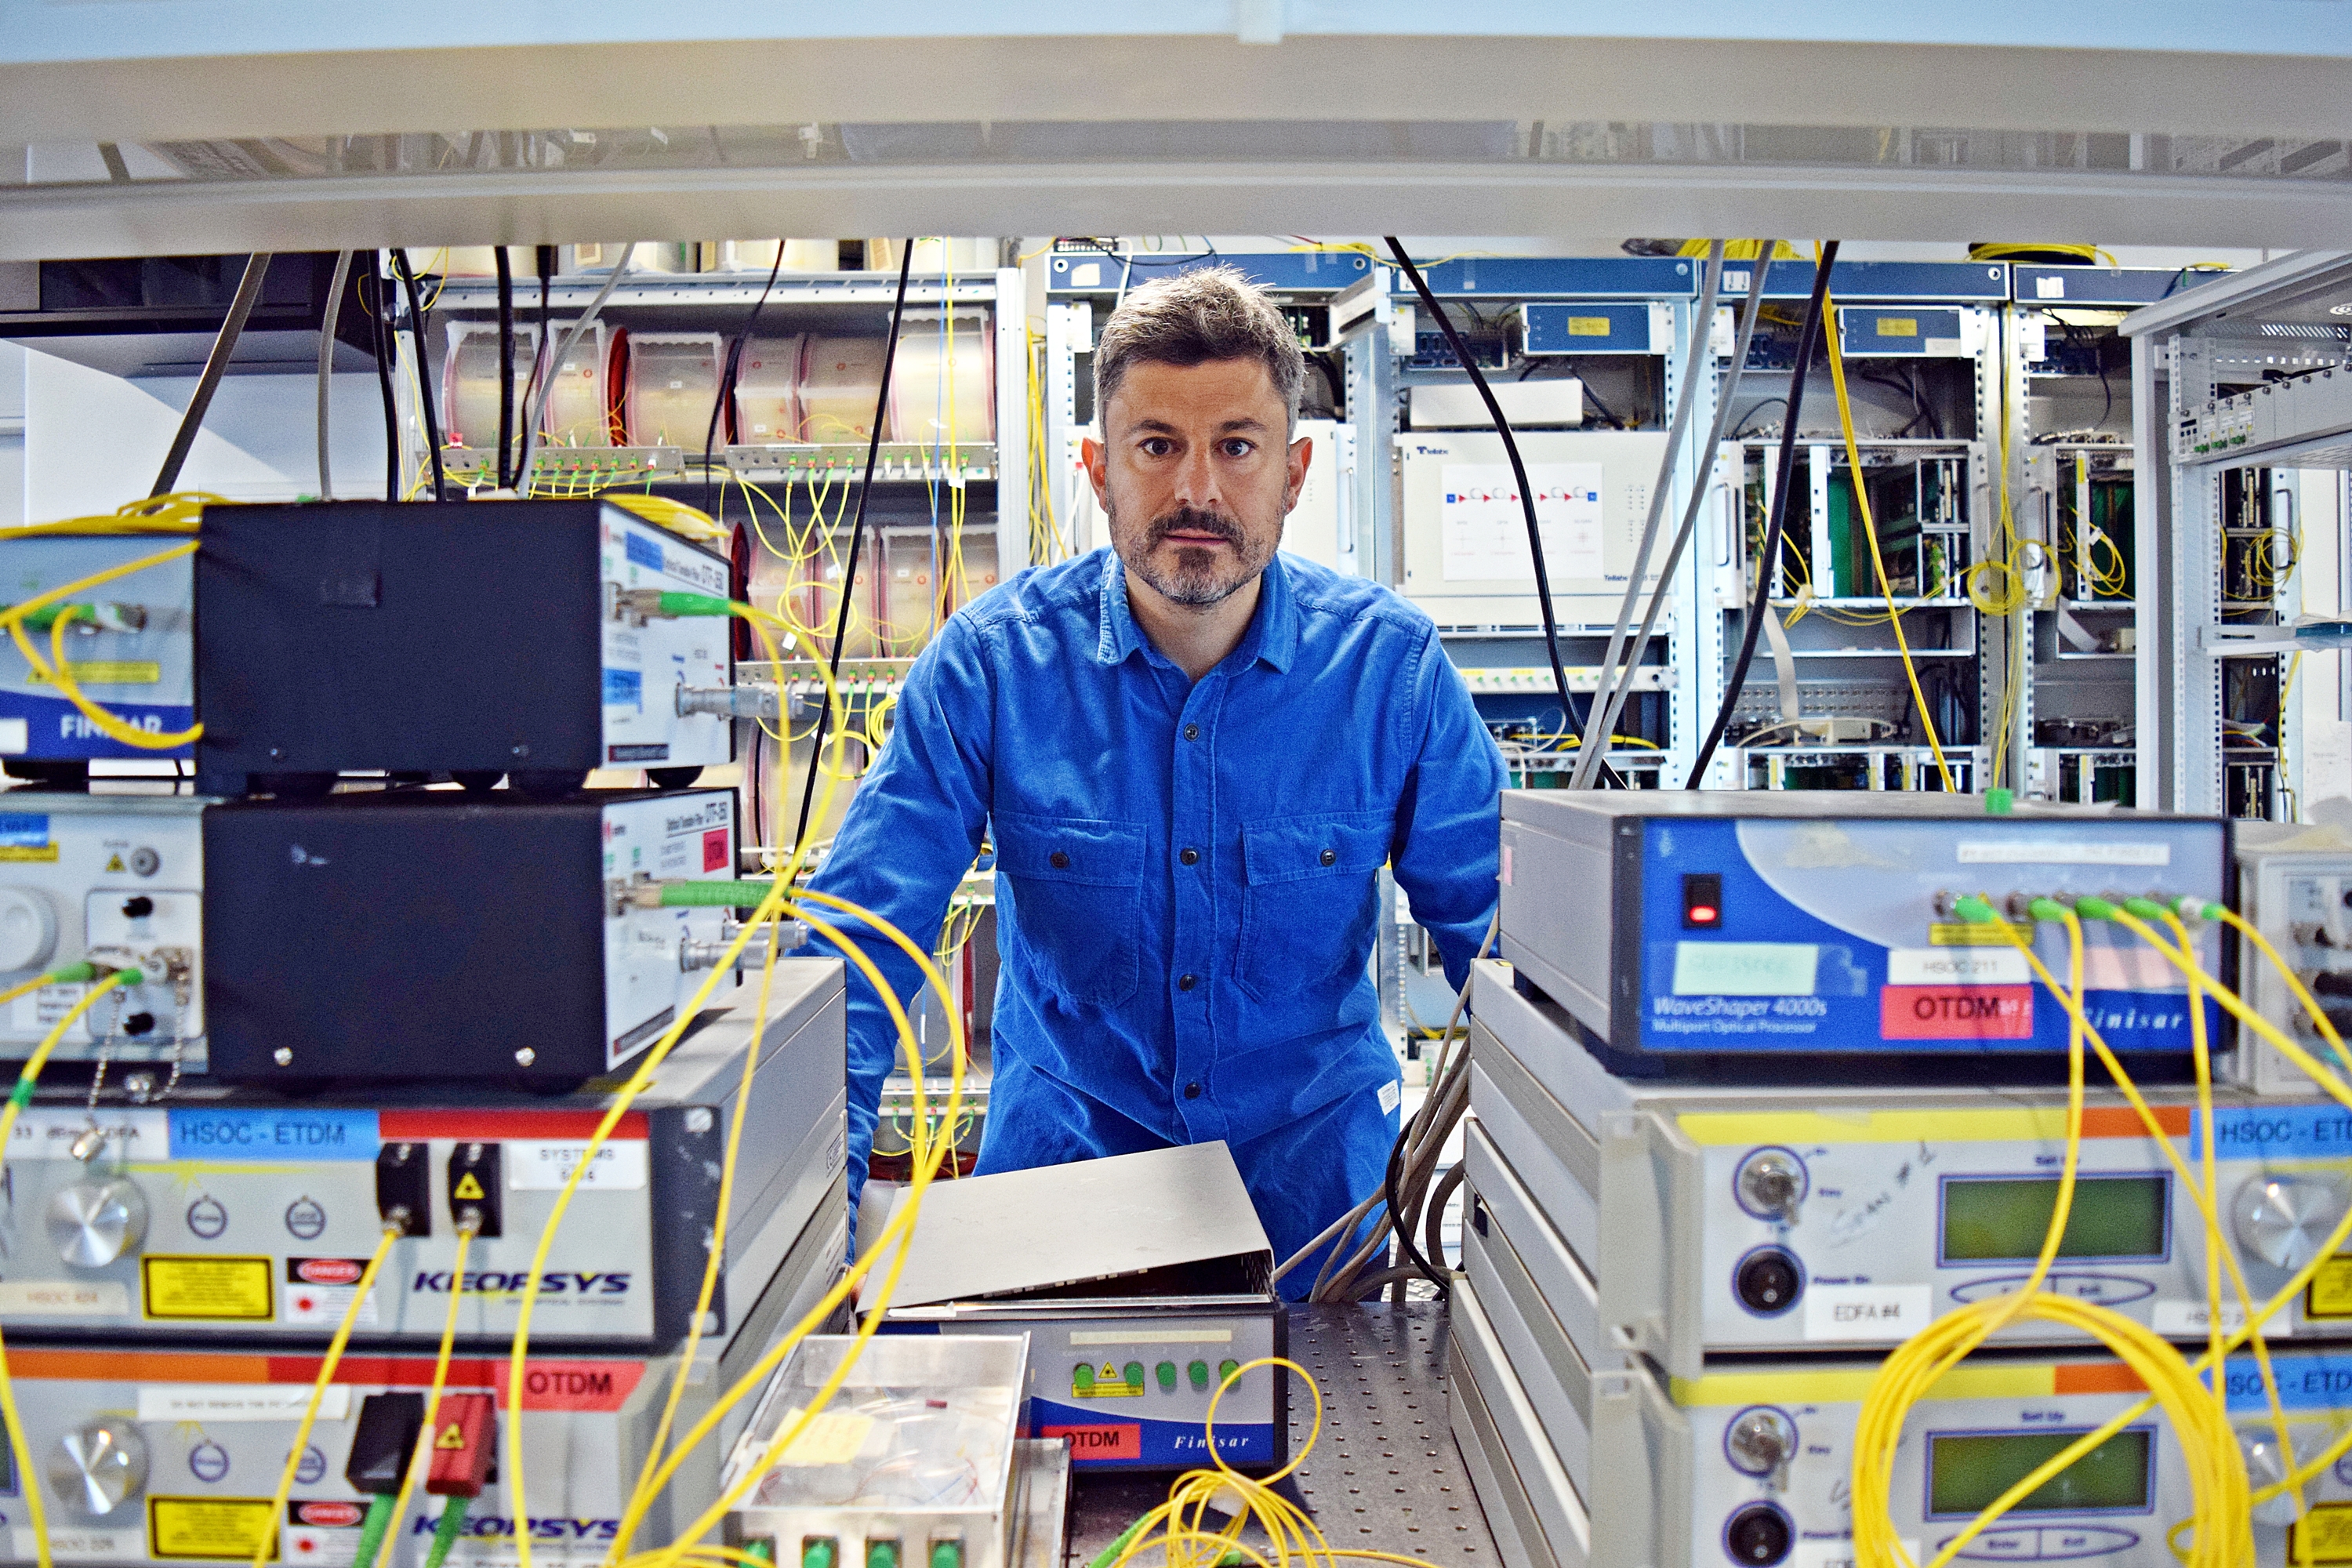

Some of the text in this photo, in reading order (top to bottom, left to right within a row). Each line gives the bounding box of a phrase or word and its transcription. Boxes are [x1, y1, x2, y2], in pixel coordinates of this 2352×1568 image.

[1922, 959, 1998, 975] HSOC 211
[1653, 996, 1828, 1019] WaveShaper 4000s
[1915, 996, 2000, 1021] OTDM
[1652, 1018, 1817, 1035] Multiport Optical Processor
[181, 1123, 252, 1145] HSOC
[274, 1122, 347, 1145] ETDM
[2220, 1120, 2291, 1142] HSOC
[1834, 1304, 1901, 1322] EDFA #4
[527, 1374, 612, 1395] OTDM
[1174, 1436, 1250, 1450] Finisar
